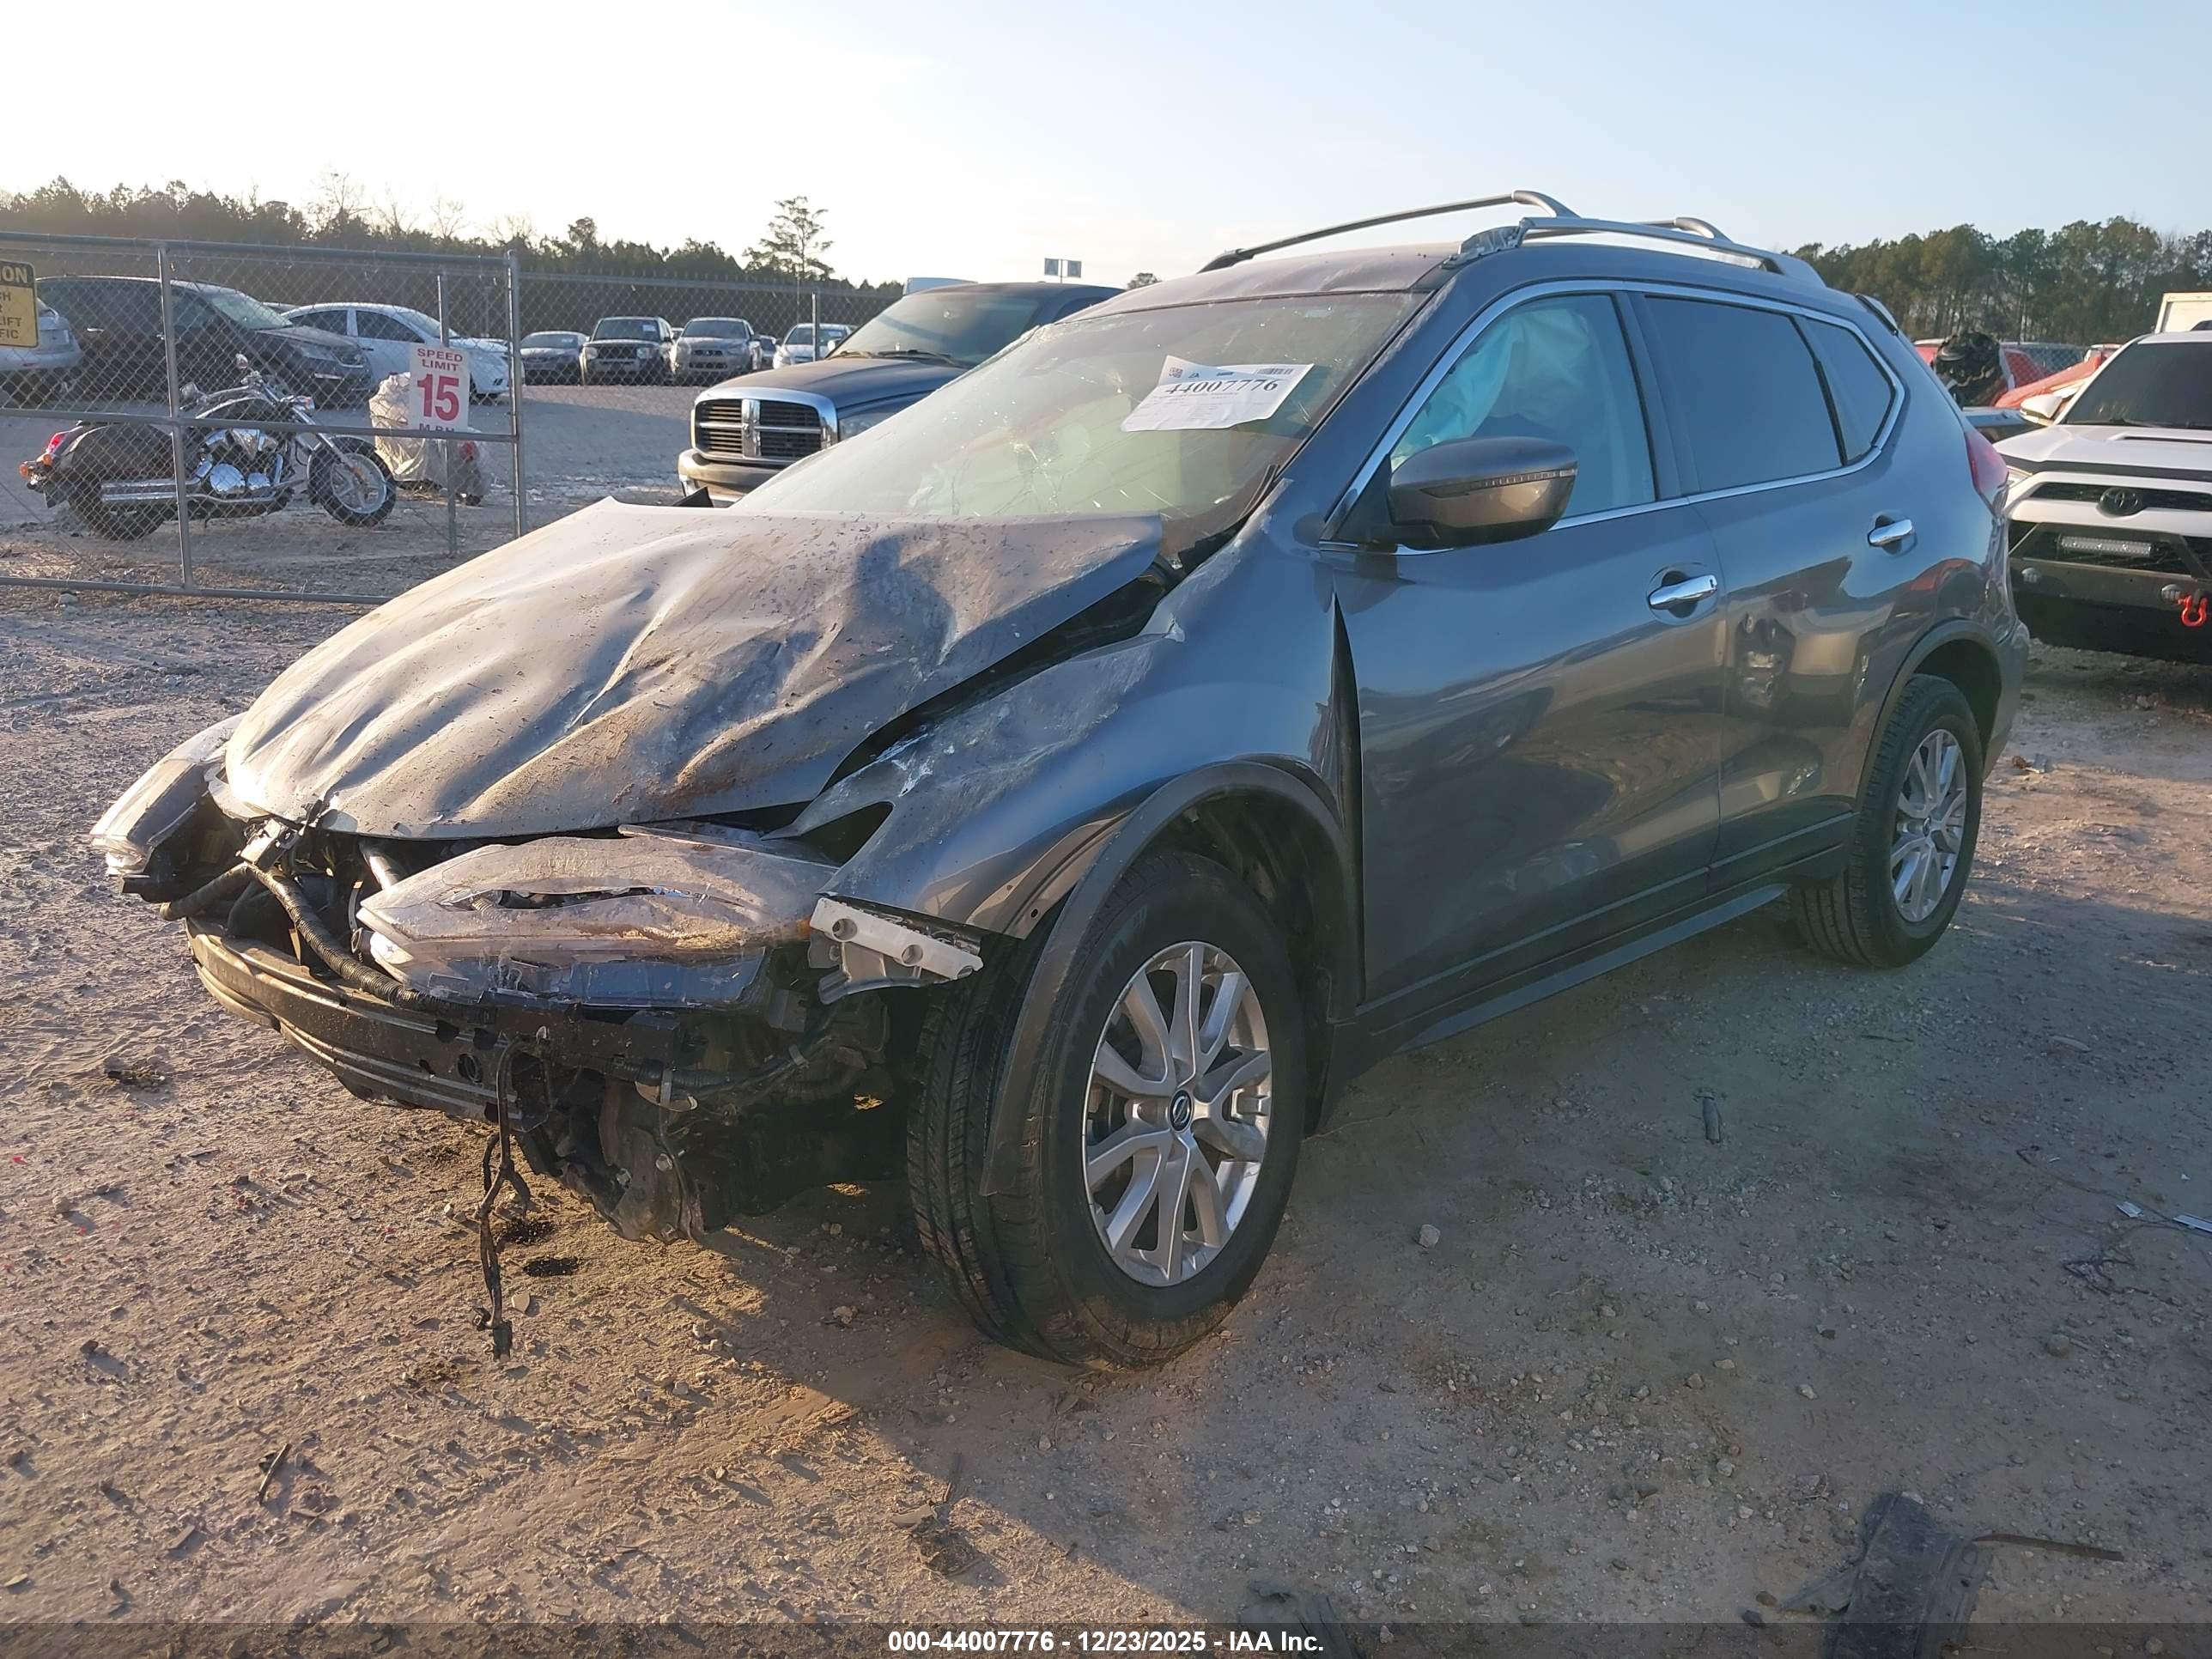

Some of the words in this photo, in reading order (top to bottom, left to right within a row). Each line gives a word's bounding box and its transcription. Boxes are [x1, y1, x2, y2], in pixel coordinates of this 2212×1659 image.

[416, 348, 463, 362] SPEED
[422, 359, 459, 372] LIMIT
[1165, 378, 1279, 394] 44007776
[416, 374, 459, 422] 15
